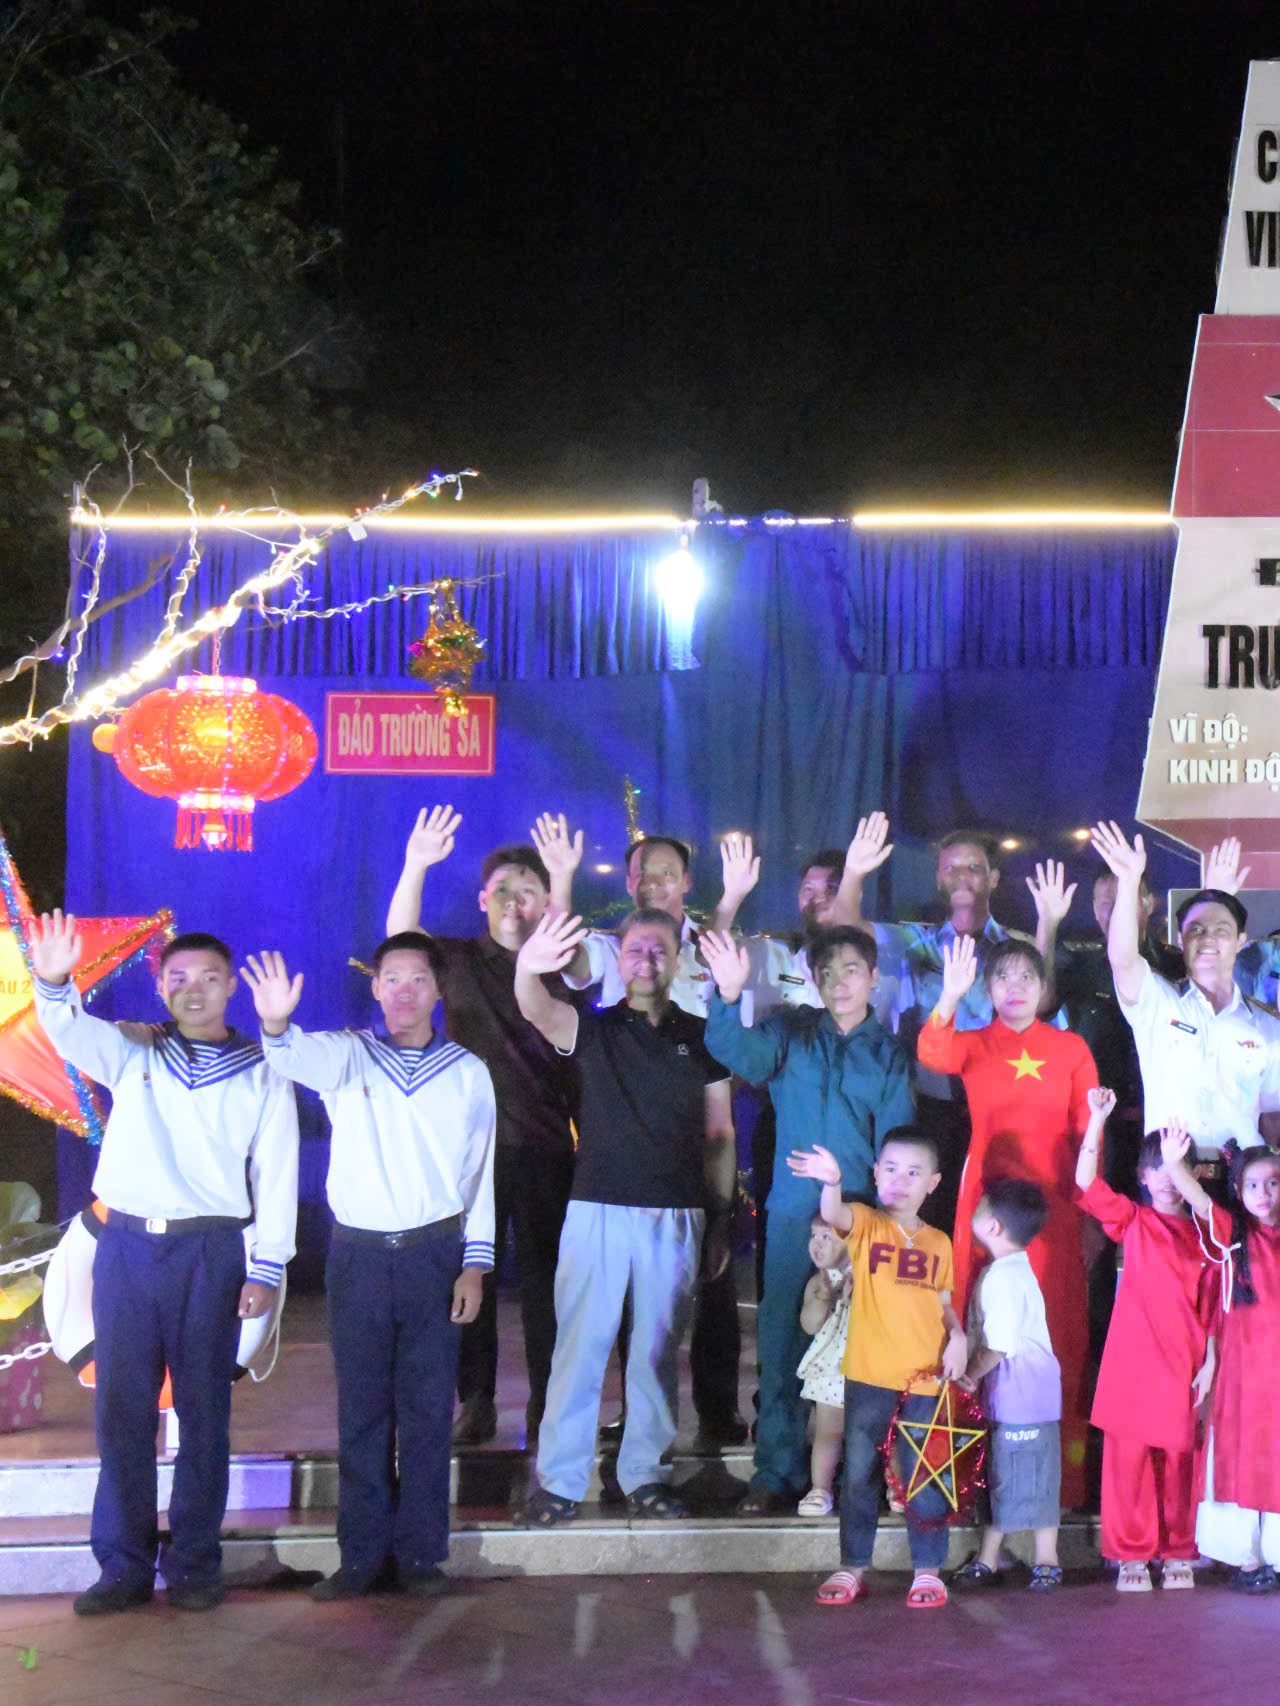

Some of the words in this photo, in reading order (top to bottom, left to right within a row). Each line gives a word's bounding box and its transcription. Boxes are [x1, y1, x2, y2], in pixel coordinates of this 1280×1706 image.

[337, 698, 374, 757] ĐẢO
[380, 703, 450, 757] TRƯỜNG
[456, 714, 480, 757] SA
[1169, 712, 1198, 744] VĨ
[1202, 713, 1248, 748] ĐỘ:
[1169, 758, 1238, 784] KINH
[869, 1242, 940, 1285] FBI
